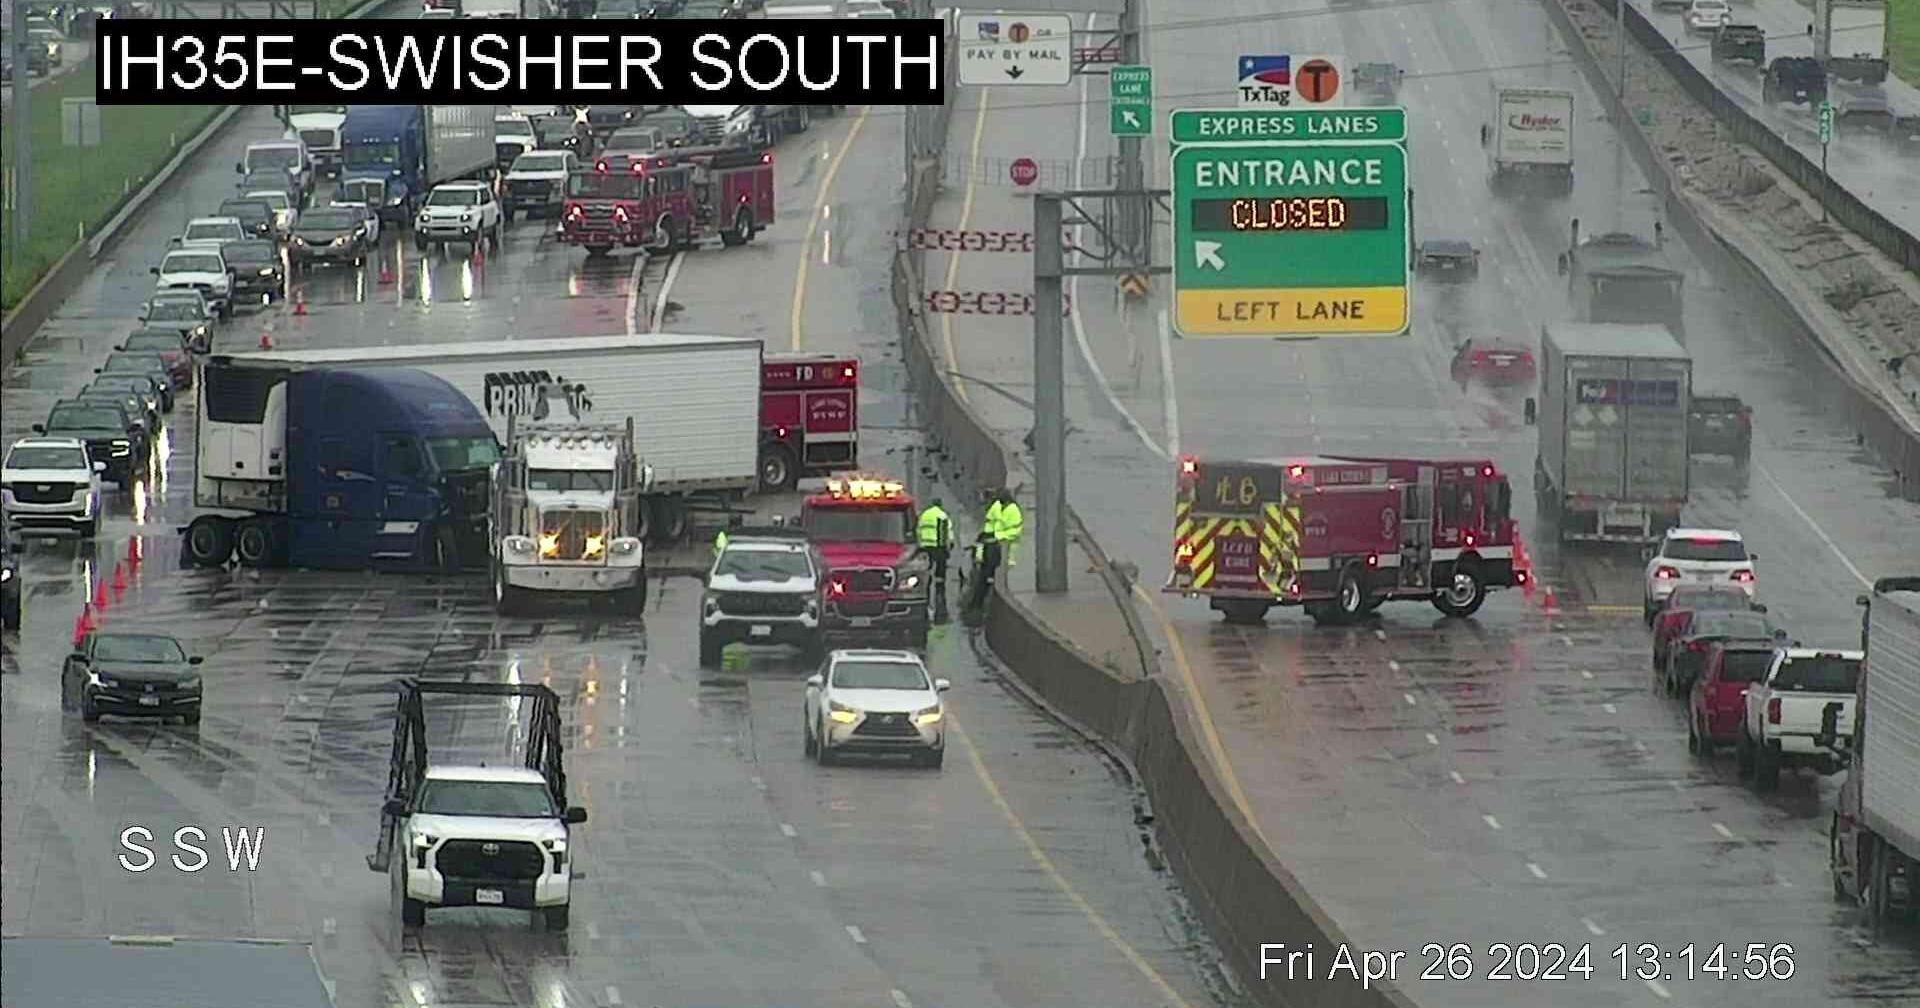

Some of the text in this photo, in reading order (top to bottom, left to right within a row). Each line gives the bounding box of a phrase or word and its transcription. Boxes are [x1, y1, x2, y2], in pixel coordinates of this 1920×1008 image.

[967, 48, 1062, 60] PAY BY MAIL
[1239, 86, 1290, 106] TxTag
[1199, 116, 1379, 135] EXPRESS LANES
[1011, 166, 1034, 179] STOP
[1195, 159, 1382, 187] ENTRANCE
[1232, 199, 1346, 229] CLOSED
[1217, 300, 1364, 321] LEFT LANE
